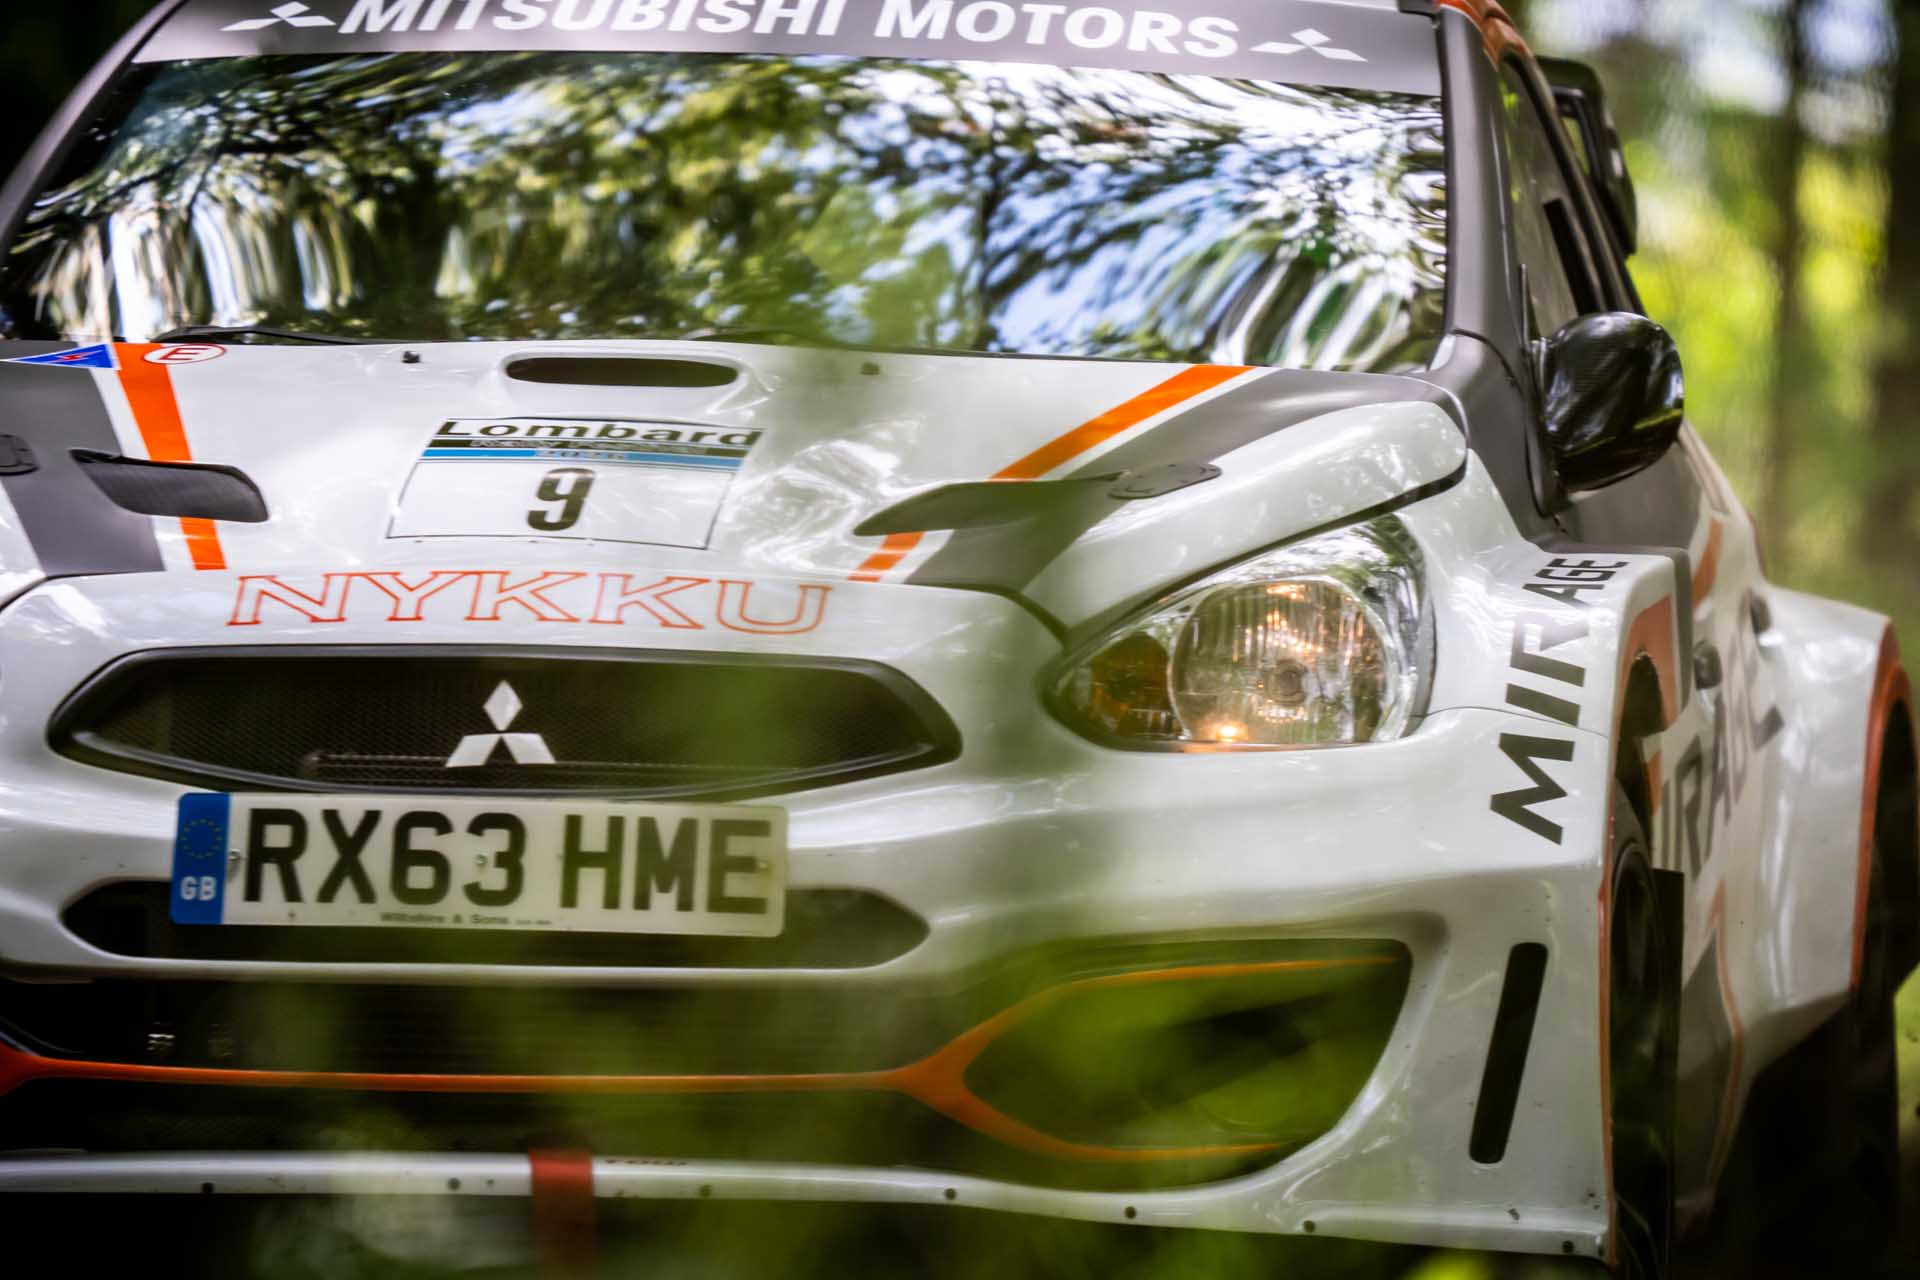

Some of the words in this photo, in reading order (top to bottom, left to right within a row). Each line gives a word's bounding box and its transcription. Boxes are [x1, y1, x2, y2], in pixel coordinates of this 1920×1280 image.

[873, 0, 1240, 59] MOTORS
[435, 420, 763, 446] Lombard
[526, 467, 597, 532] 9
[226, 569, 833, 636] NYKKU
[1489, 556, 1629, 846] MIRAGE
[179, 876, 218, 900] GB
[243, 807, 527, 906] RX63
[559, 814, 773, 914] HME
